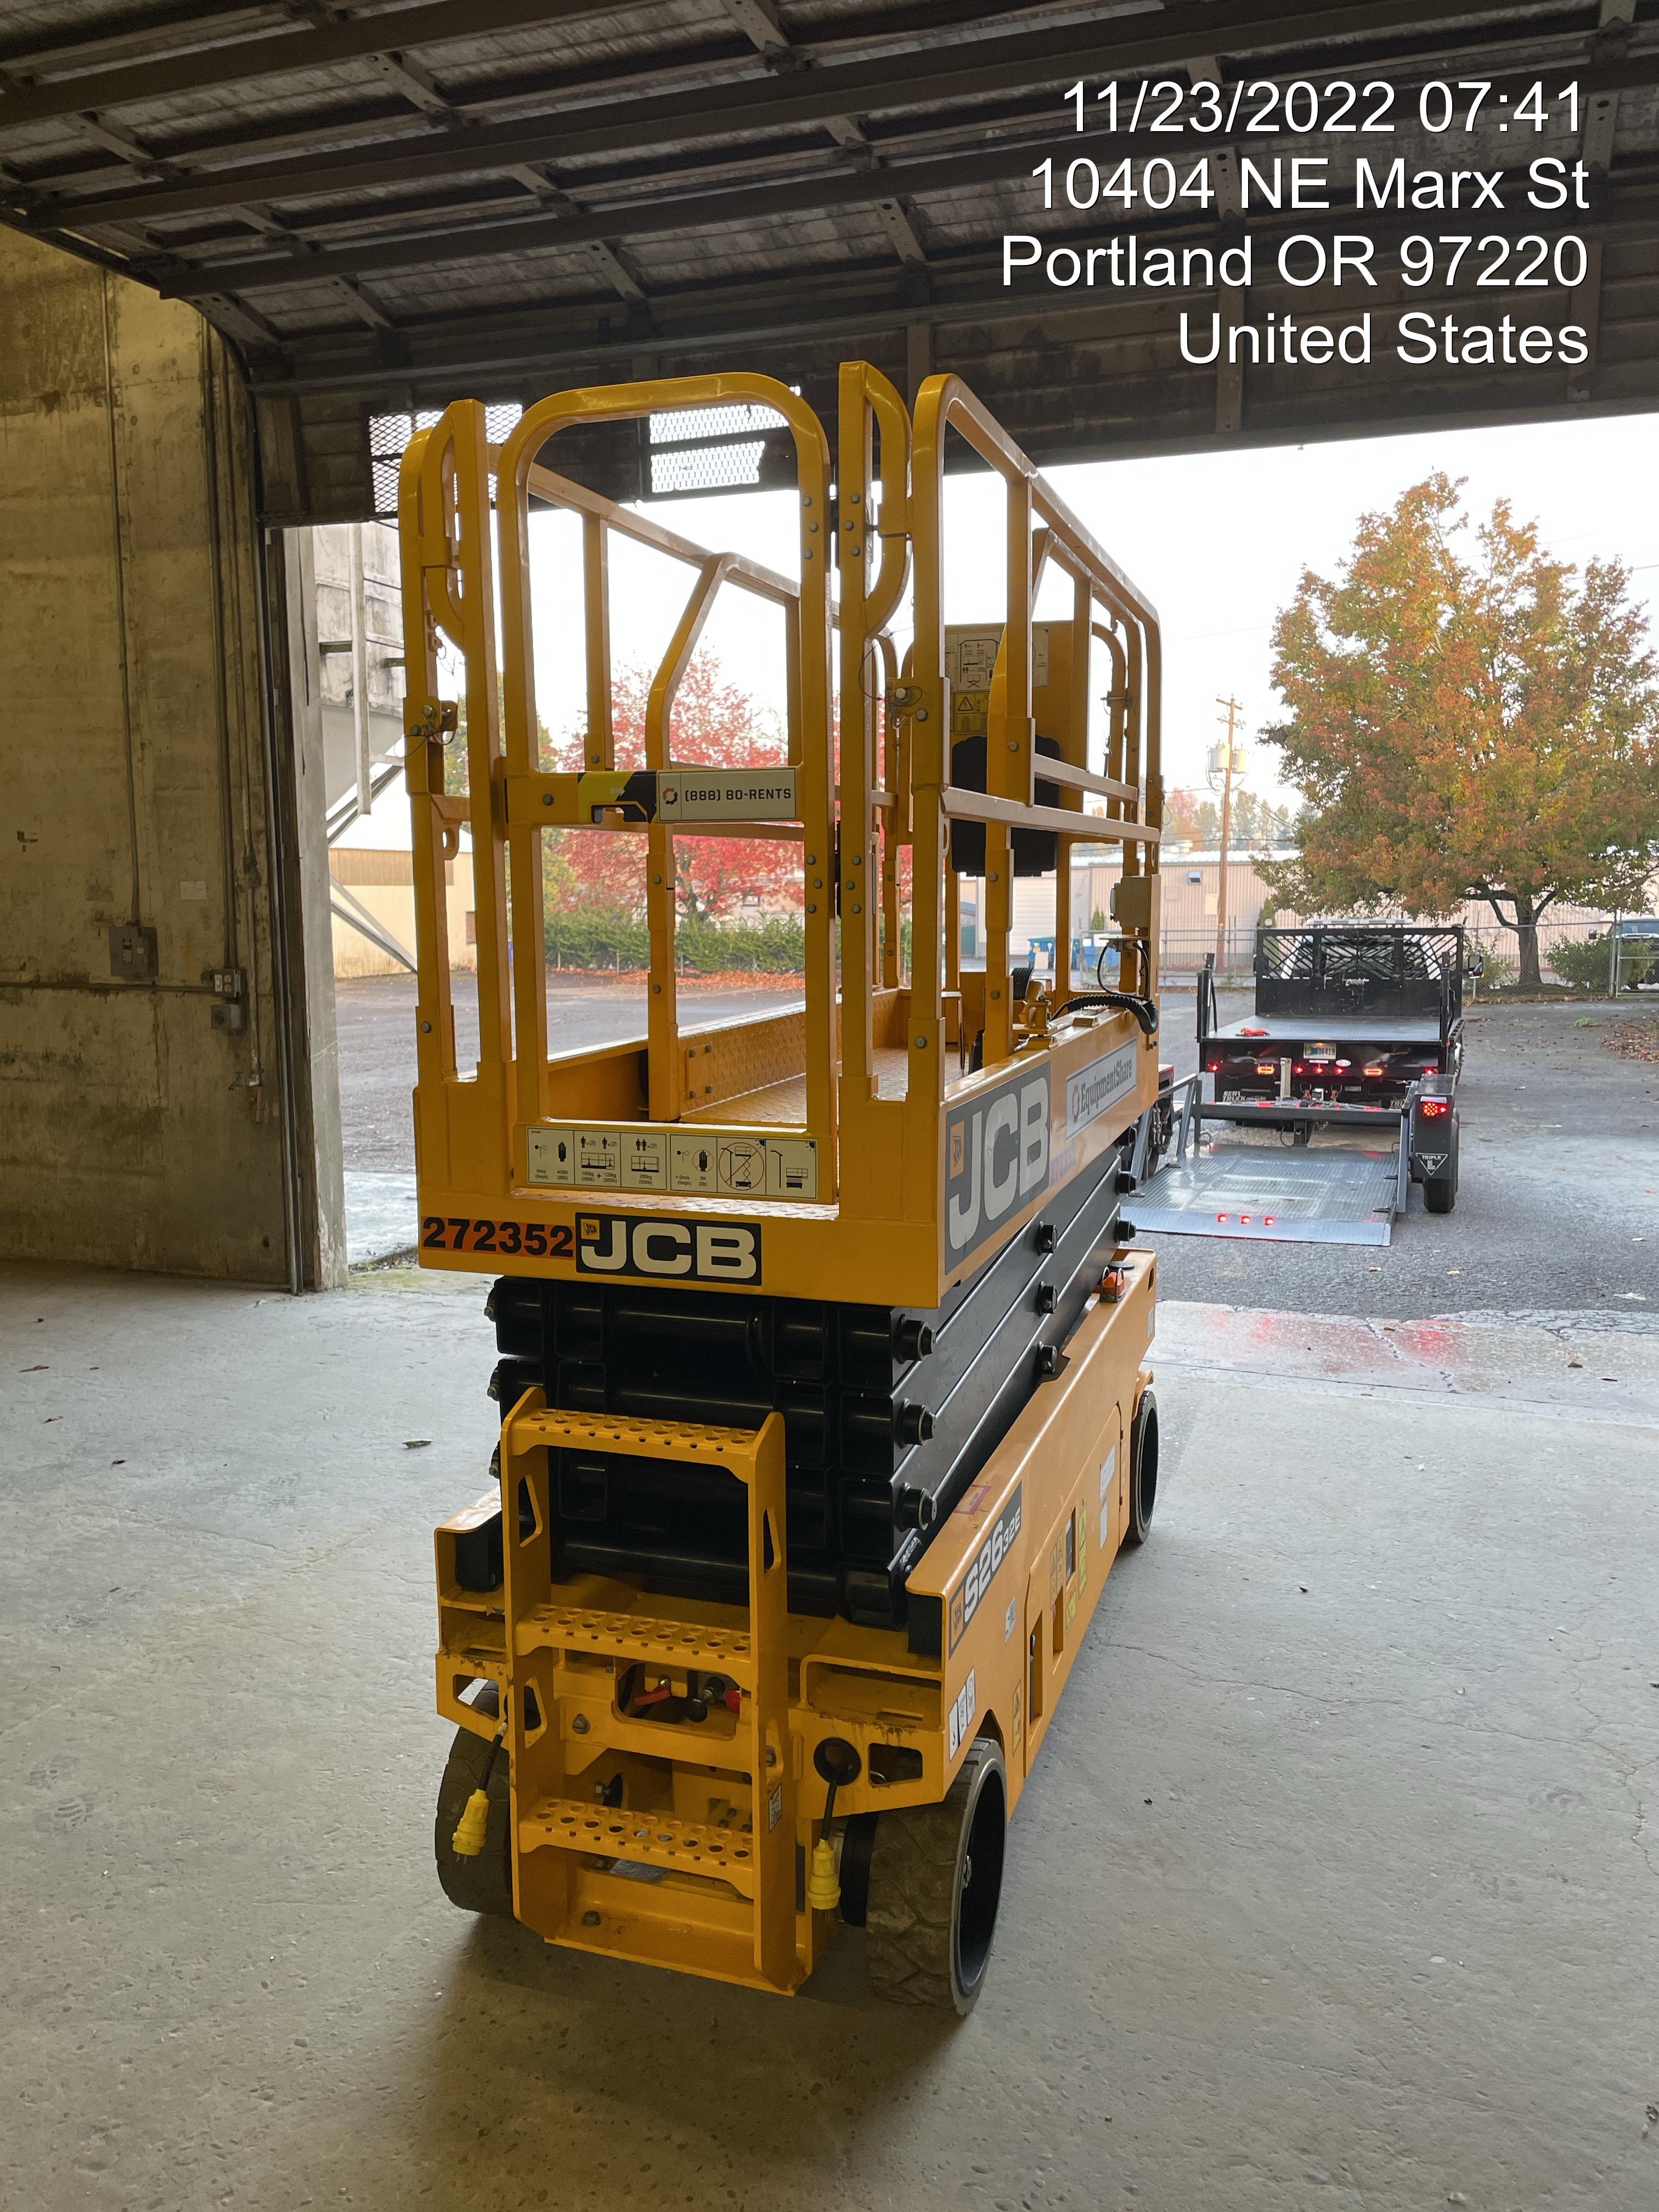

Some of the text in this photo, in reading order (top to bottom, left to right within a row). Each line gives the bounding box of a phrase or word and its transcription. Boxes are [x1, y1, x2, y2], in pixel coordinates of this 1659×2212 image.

[685, 788, 792, 802] (888) 80-RENTS
[1080, 1058, 1132, 1116] EquipmentShare
[949, 1077, 1048, 1250] JCB
[422, 1217, 573, 1258] 272352
[581, 1220, 757, 1279] JCB
